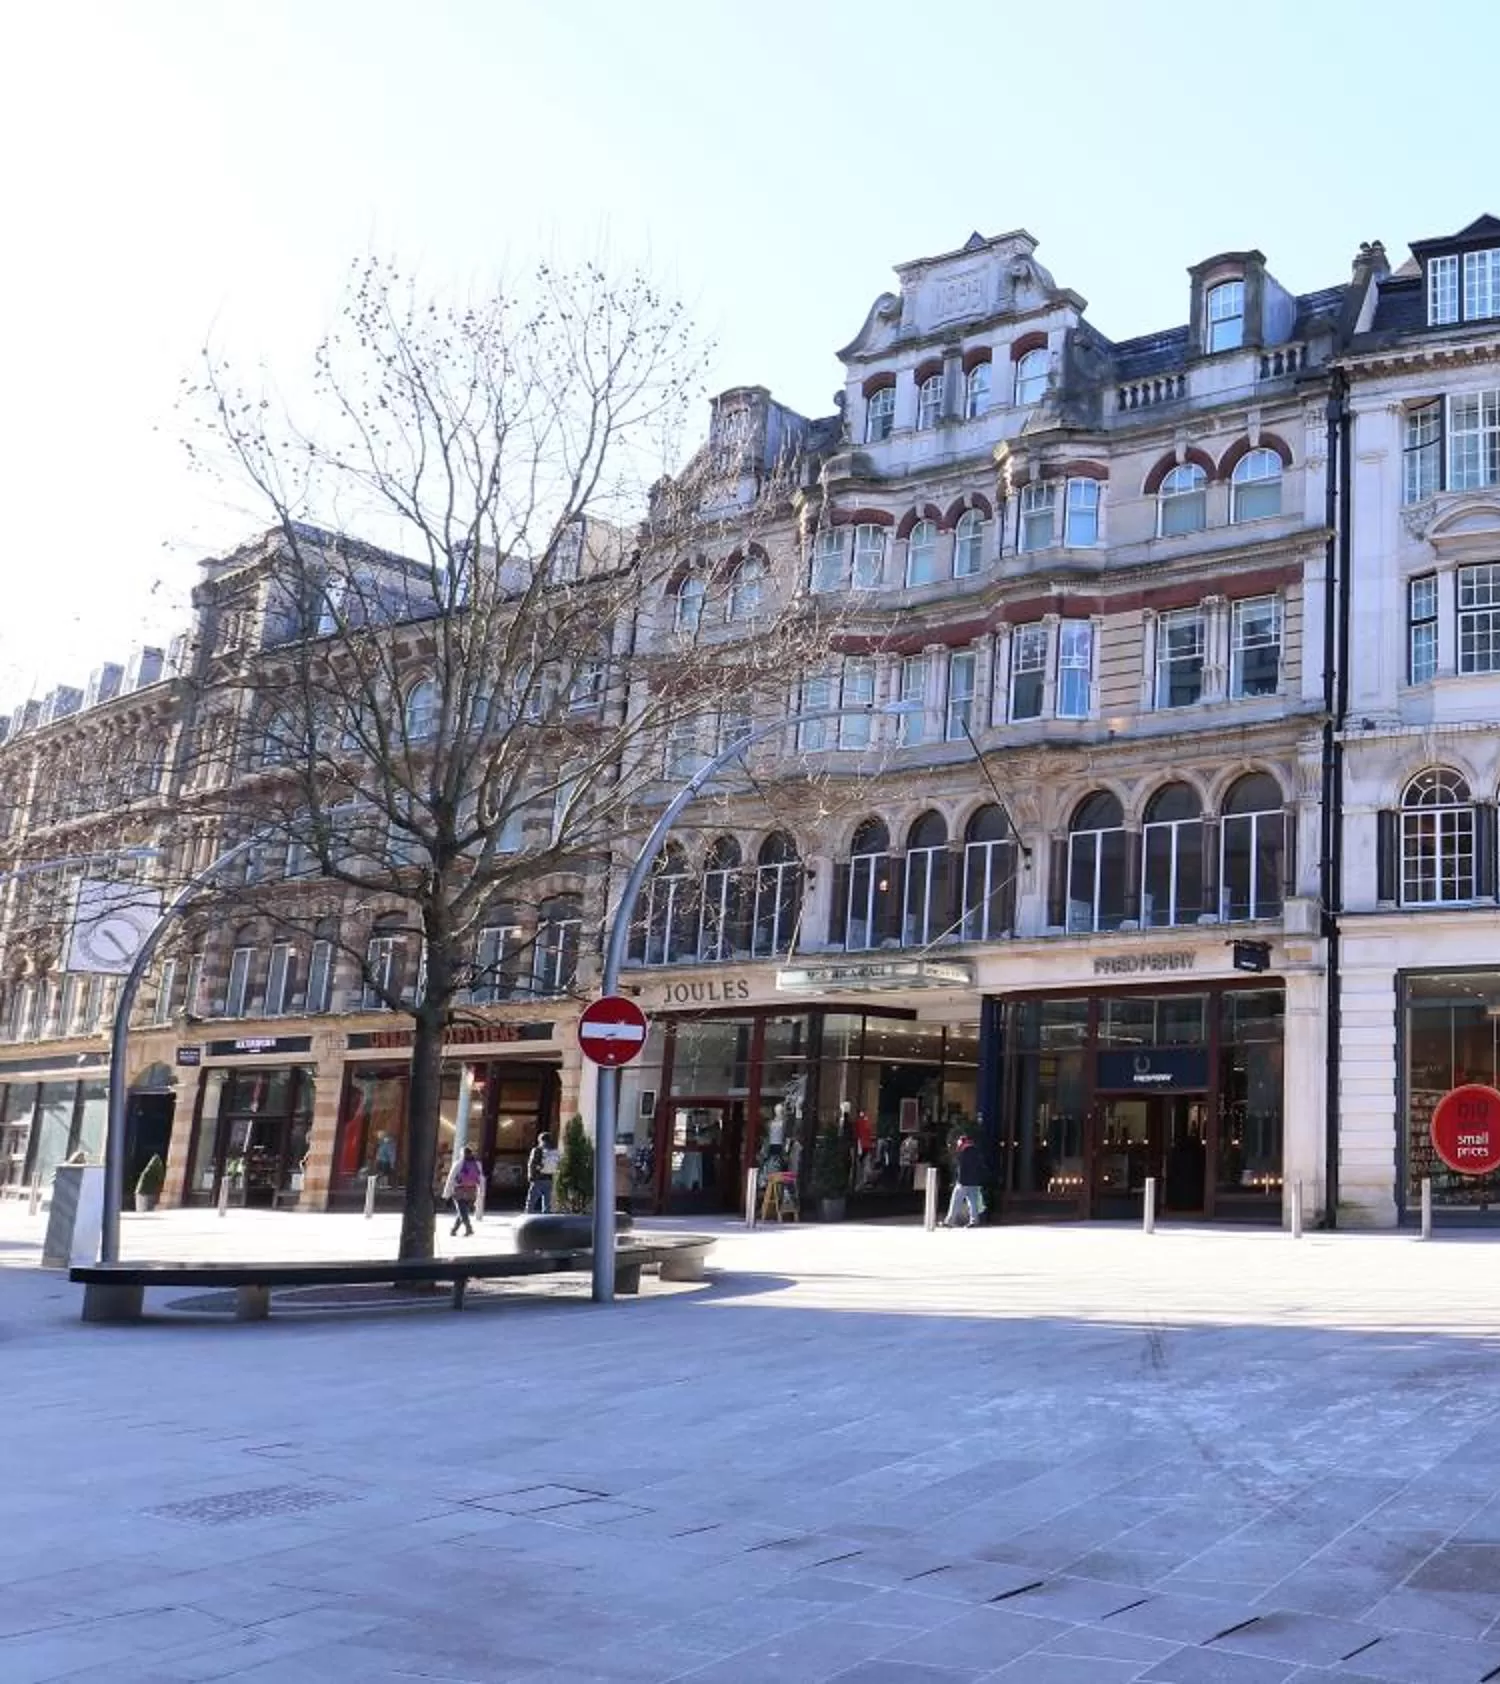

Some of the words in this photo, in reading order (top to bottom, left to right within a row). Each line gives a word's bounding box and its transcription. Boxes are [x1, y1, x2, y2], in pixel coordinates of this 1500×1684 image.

[1094, 955, 1138, 974] FRED
[1140, 951, 1197, 972] PERRY
[664, 980, 749, 1003] JOULES
[1457, 1131, 1489, 1145] small
[1457, 1147, 1489, 1159] prices
